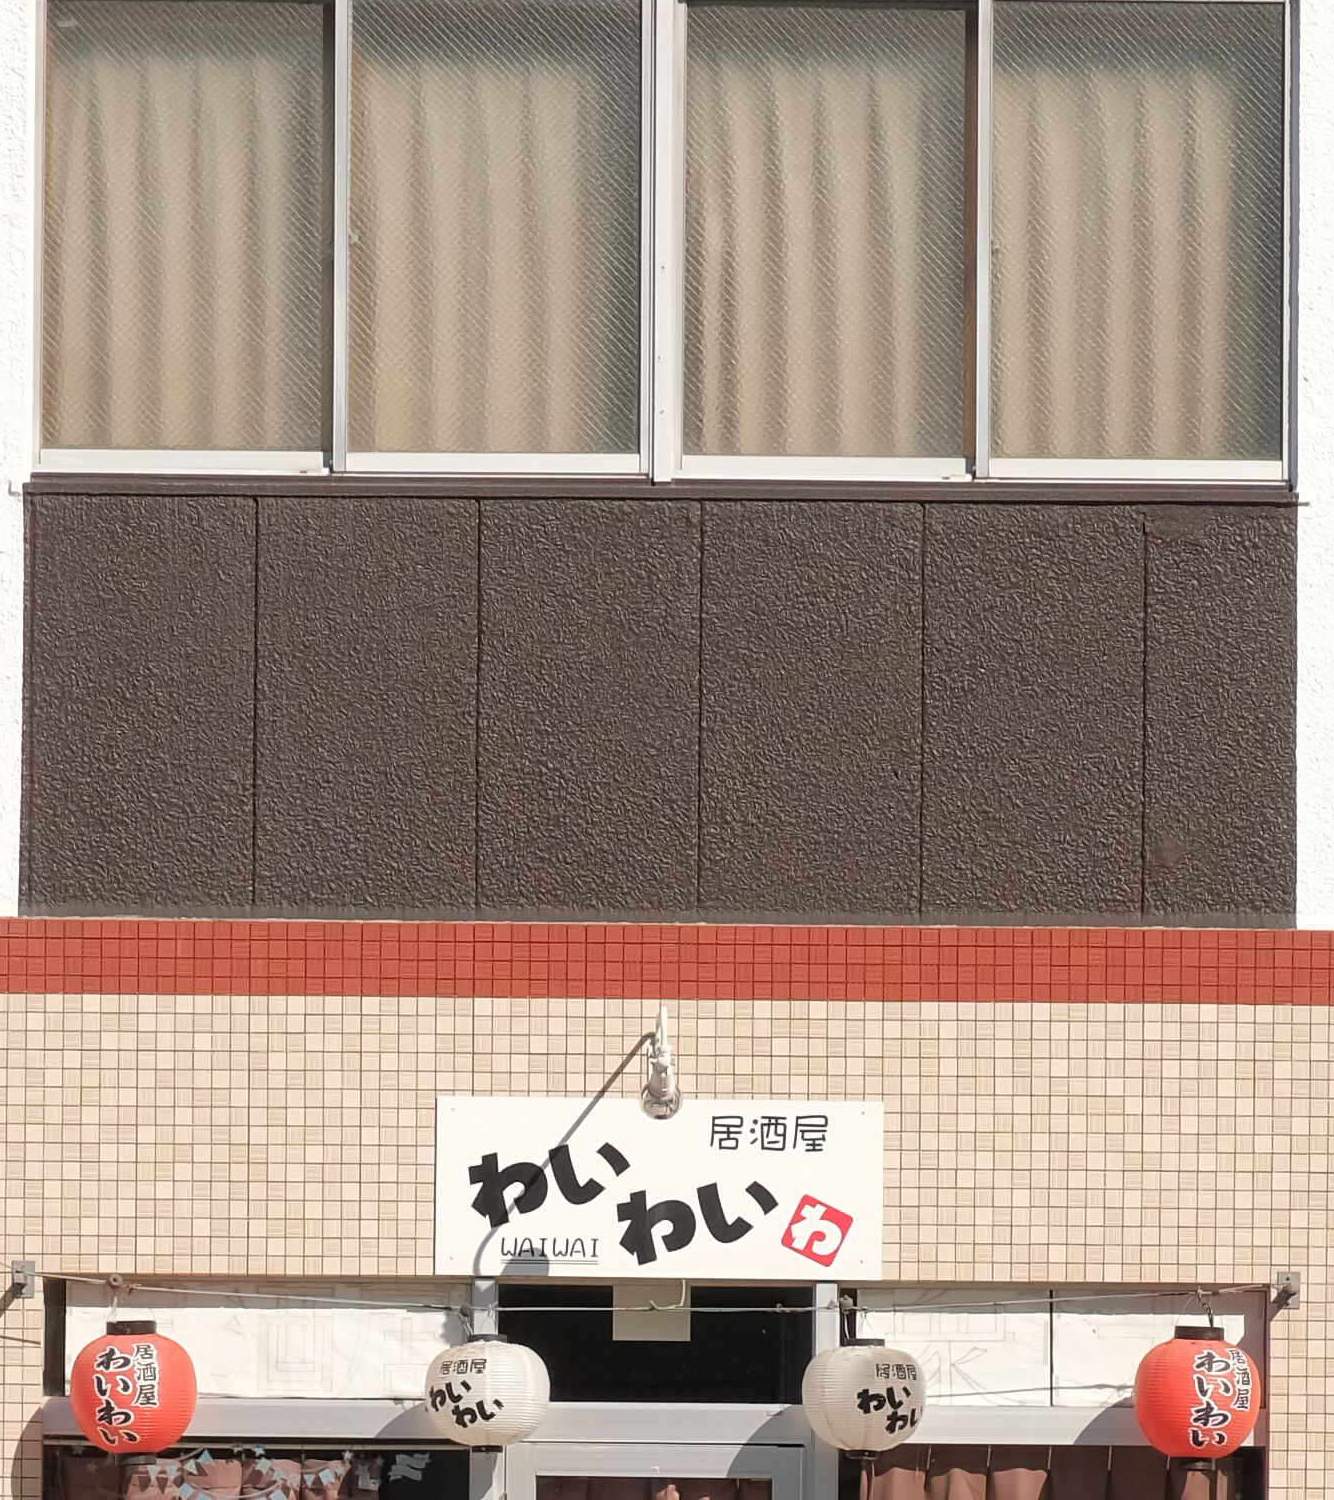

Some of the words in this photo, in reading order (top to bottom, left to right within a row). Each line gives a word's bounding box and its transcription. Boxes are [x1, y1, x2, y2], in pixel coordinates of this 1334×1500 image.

[710, 1114, 829, 1152] 居酒屋
[500, 1237, 601, 1258] WAIWAI
[133, 1343, 158, 1406] 居酒屋
[440, 1359, 487, 1375] 居酒屋
[876, 1363, 917, 1380] 居酒屋
[1227, 1349, 1250, 1410] 居酒屋
[95, 1347, 138, 1445] わいわい
[1192, 1351, 1231, 1447] わいわい
